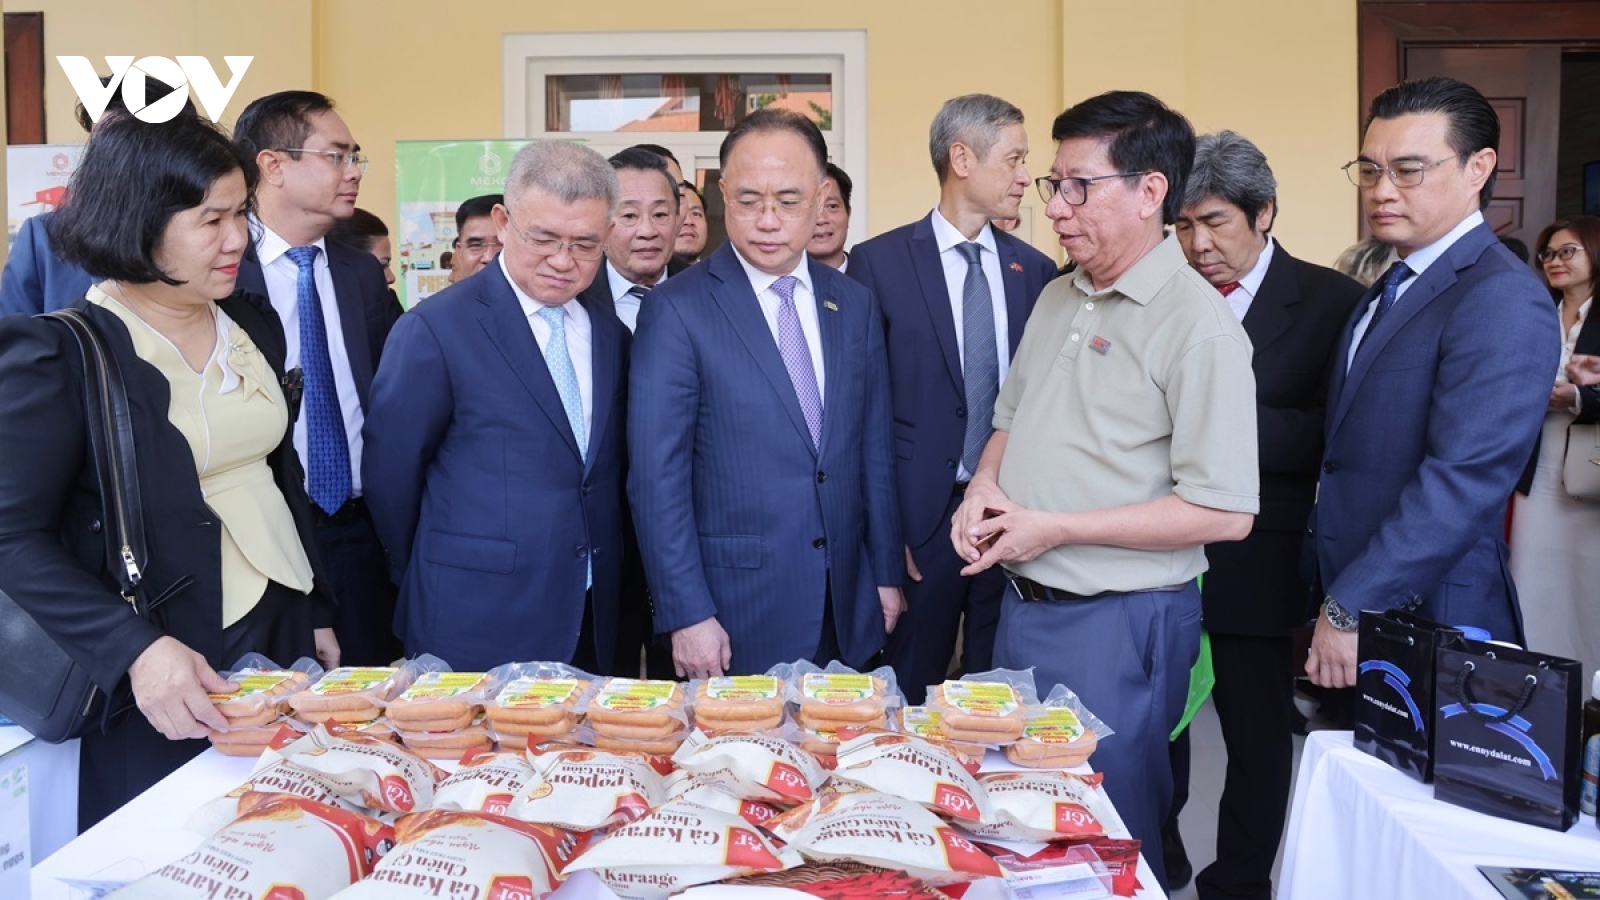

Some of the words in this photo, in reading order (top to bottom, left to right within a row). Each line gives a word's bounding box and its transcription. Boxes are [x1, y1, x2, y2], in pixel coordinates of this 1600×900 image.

[1363, 693, 1409, 719] www.ennydalat.com
[1449, 738, 1532, 767] www.ennydalat.com
[774, 771, 807, 787] AGF
[386, 785, 412, 804] AGF
[939, 793, 974, 812] AGF
[651, 813, 702, 828] Chiên
[744, 804, 779, 820] AGF
[1061, 811, 1094, 827] AGF
[863, 818, 911, 831] Chiên
[607, 827, 683, 843] Karaa
[690, 829, 720, 846] Gà
[904, 832, 936, 847] Gà
[203, 854, 249, 883] Chiên
[416, 856, 468, 877] Chiên
[152, 864, 223, 900] Karaa
[366, 869, 445, 897] Karaa
[604, 868, 678, 888] Karaage
